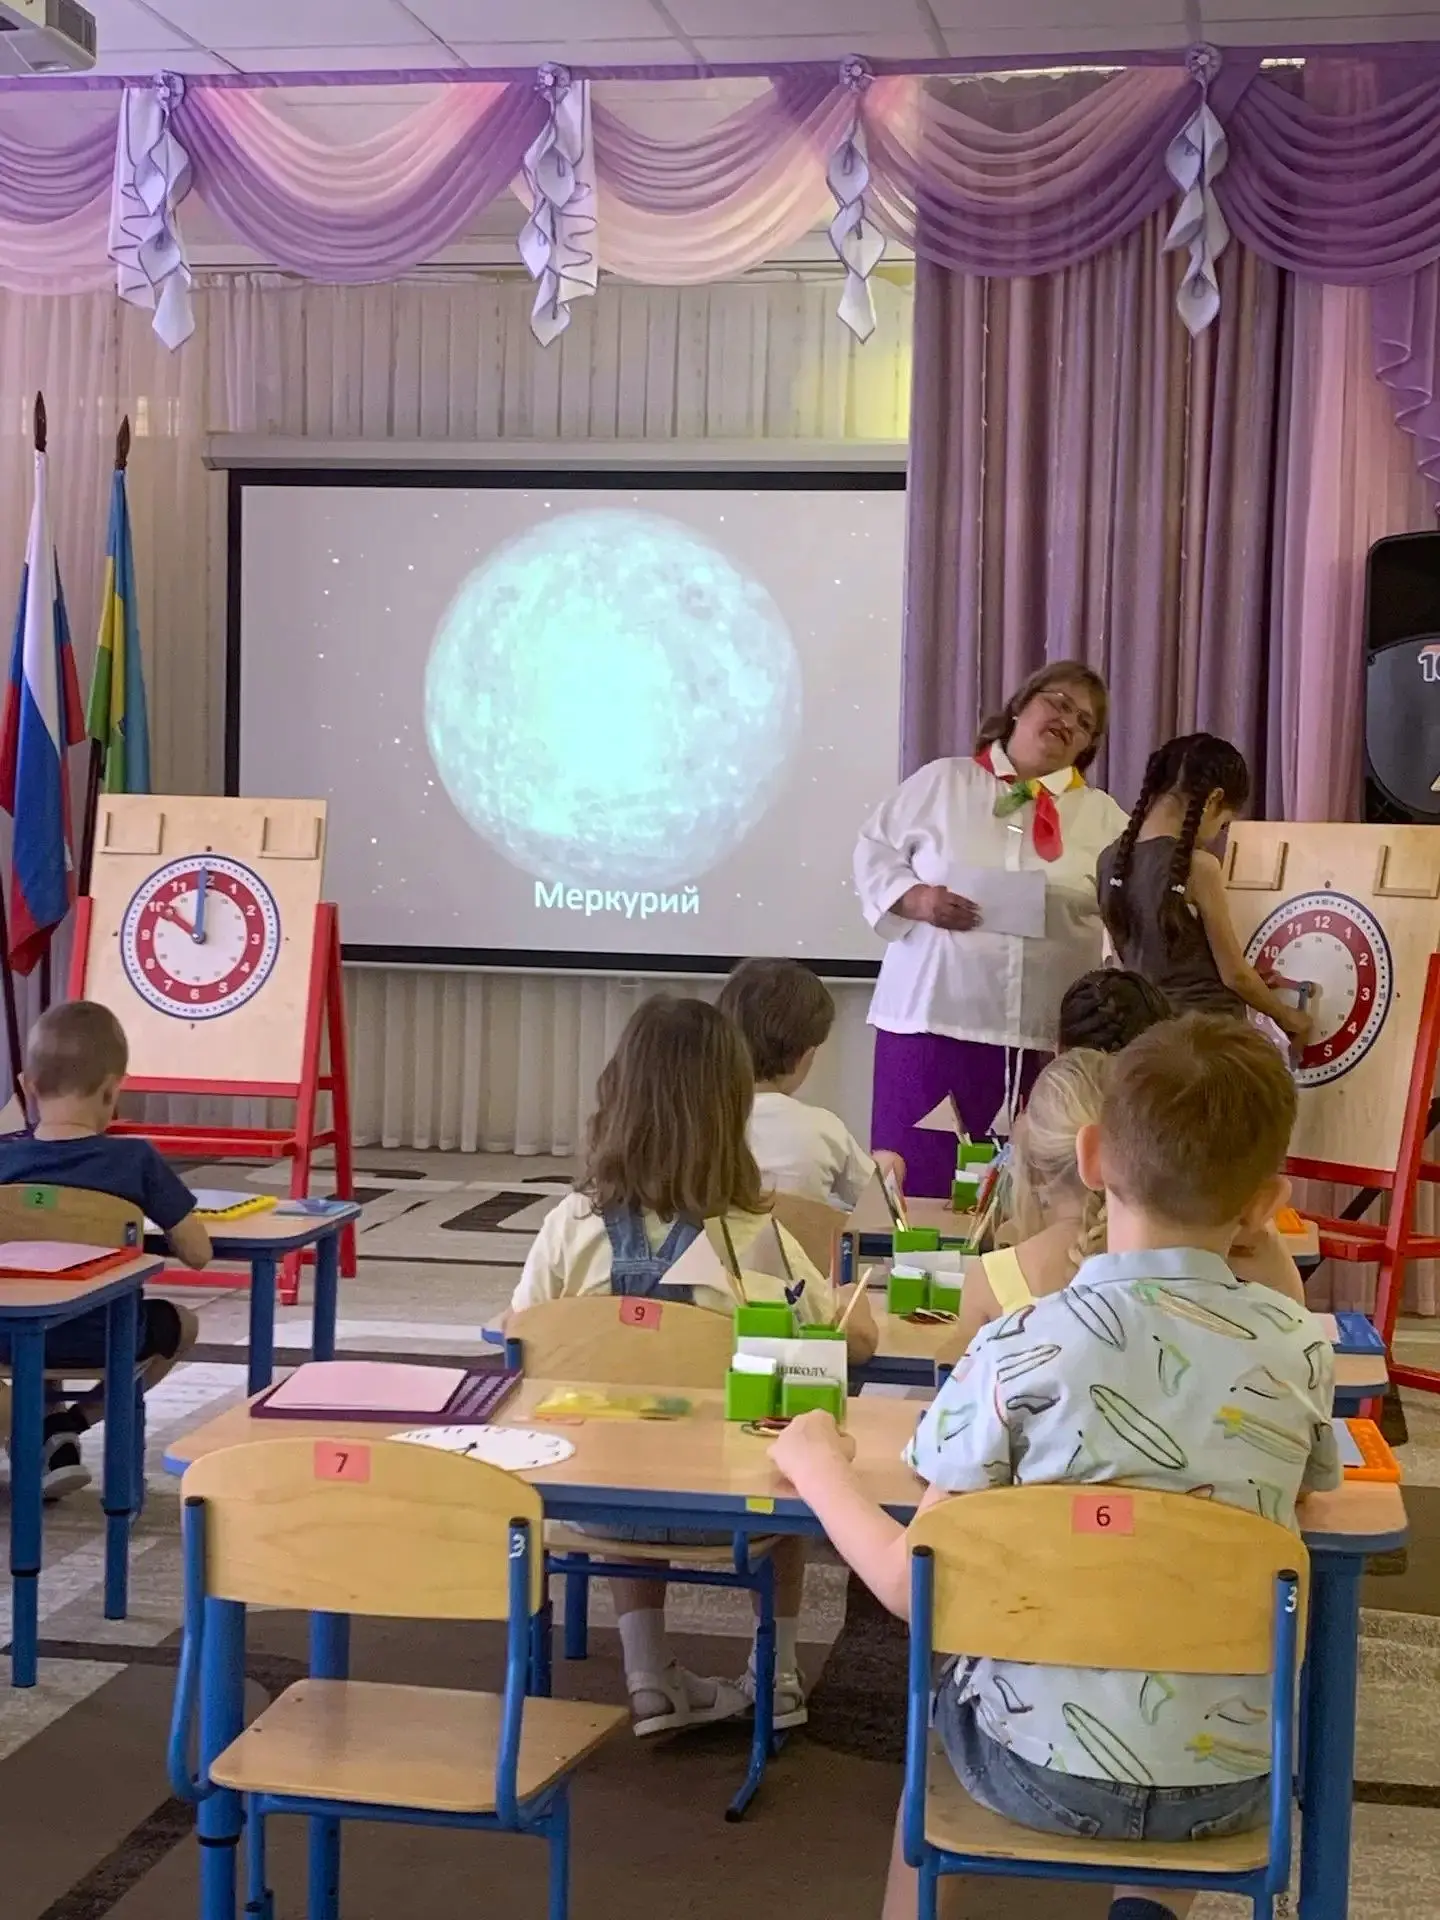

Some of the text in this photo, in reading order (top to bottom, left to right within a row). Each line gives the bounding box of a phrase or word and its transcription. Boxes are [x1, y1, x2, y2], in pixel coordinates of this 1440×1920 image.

[1417, 651, 1440, 682] 1
[170, 881, 187, 892] 11
[230, 883, 237, 895] 1
[534, 880, 700, 920] Меркурий
[246, 905, 256, 916] 2
[1286, 922, 1302, 936] 11
[1314, 915, 1331, 929] 12
[141, 929, 150, 940] 9
[251, 933, 260, 945] 3
[1344, 926, 1352, 939] 1
[1263, 945, 1279, 959] 10
[1359, 953, 1369, 966] 2
[240, 962, 250, 973] 4
[164, 979, 173, 991] 7
[219, 982, 228, 993] 5
[190, 988, 200, 1000] 6
[1360, 987, 1370, 1001] 3
[1347, 1021, 1357, 1035] 4
[1323, 1044, 1333, 1057] 5
[34, 1191, 44, 1205] 2
[634, 1306, 645, 1321] 9
[335, 1452, 349, 1473] 7
[1096, 1505, 1111, 1527] 6
[509, 1533, 526, 1559] 3
[1284, 1586, 1298, 1613] 3
